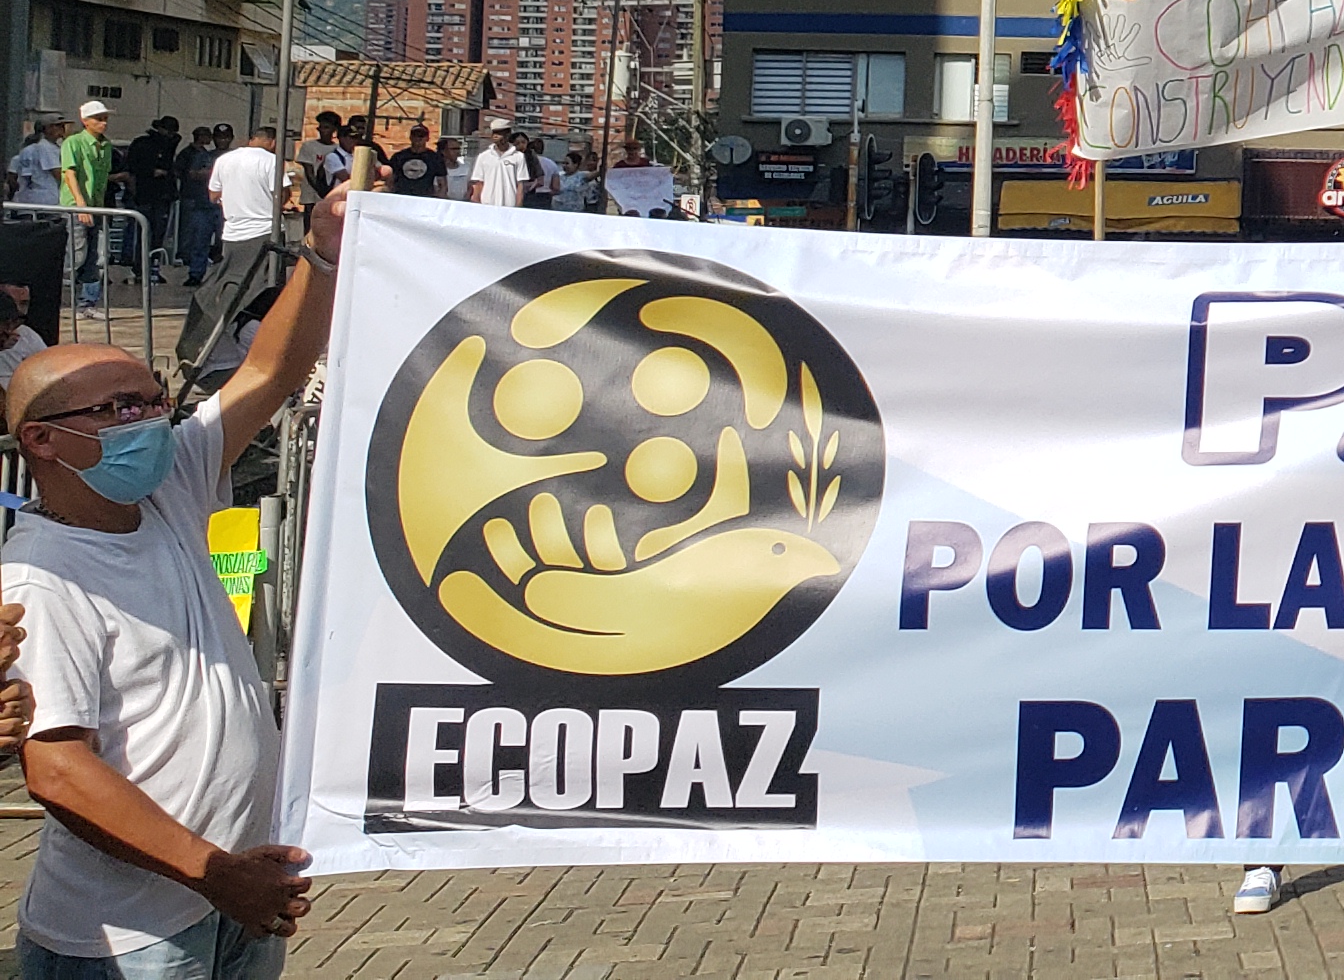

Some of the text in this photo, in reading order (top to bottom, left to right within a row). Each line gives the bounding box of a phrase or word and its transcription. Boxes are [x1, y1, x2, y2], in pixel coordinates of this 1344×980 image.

[958, 142, 1062, 165] HADERÍA
[1150, 193, 1207, 206] AGUILA
[898, 520, 1167, 632] POR
[402, 706, 797, 812] ECOPAZ
